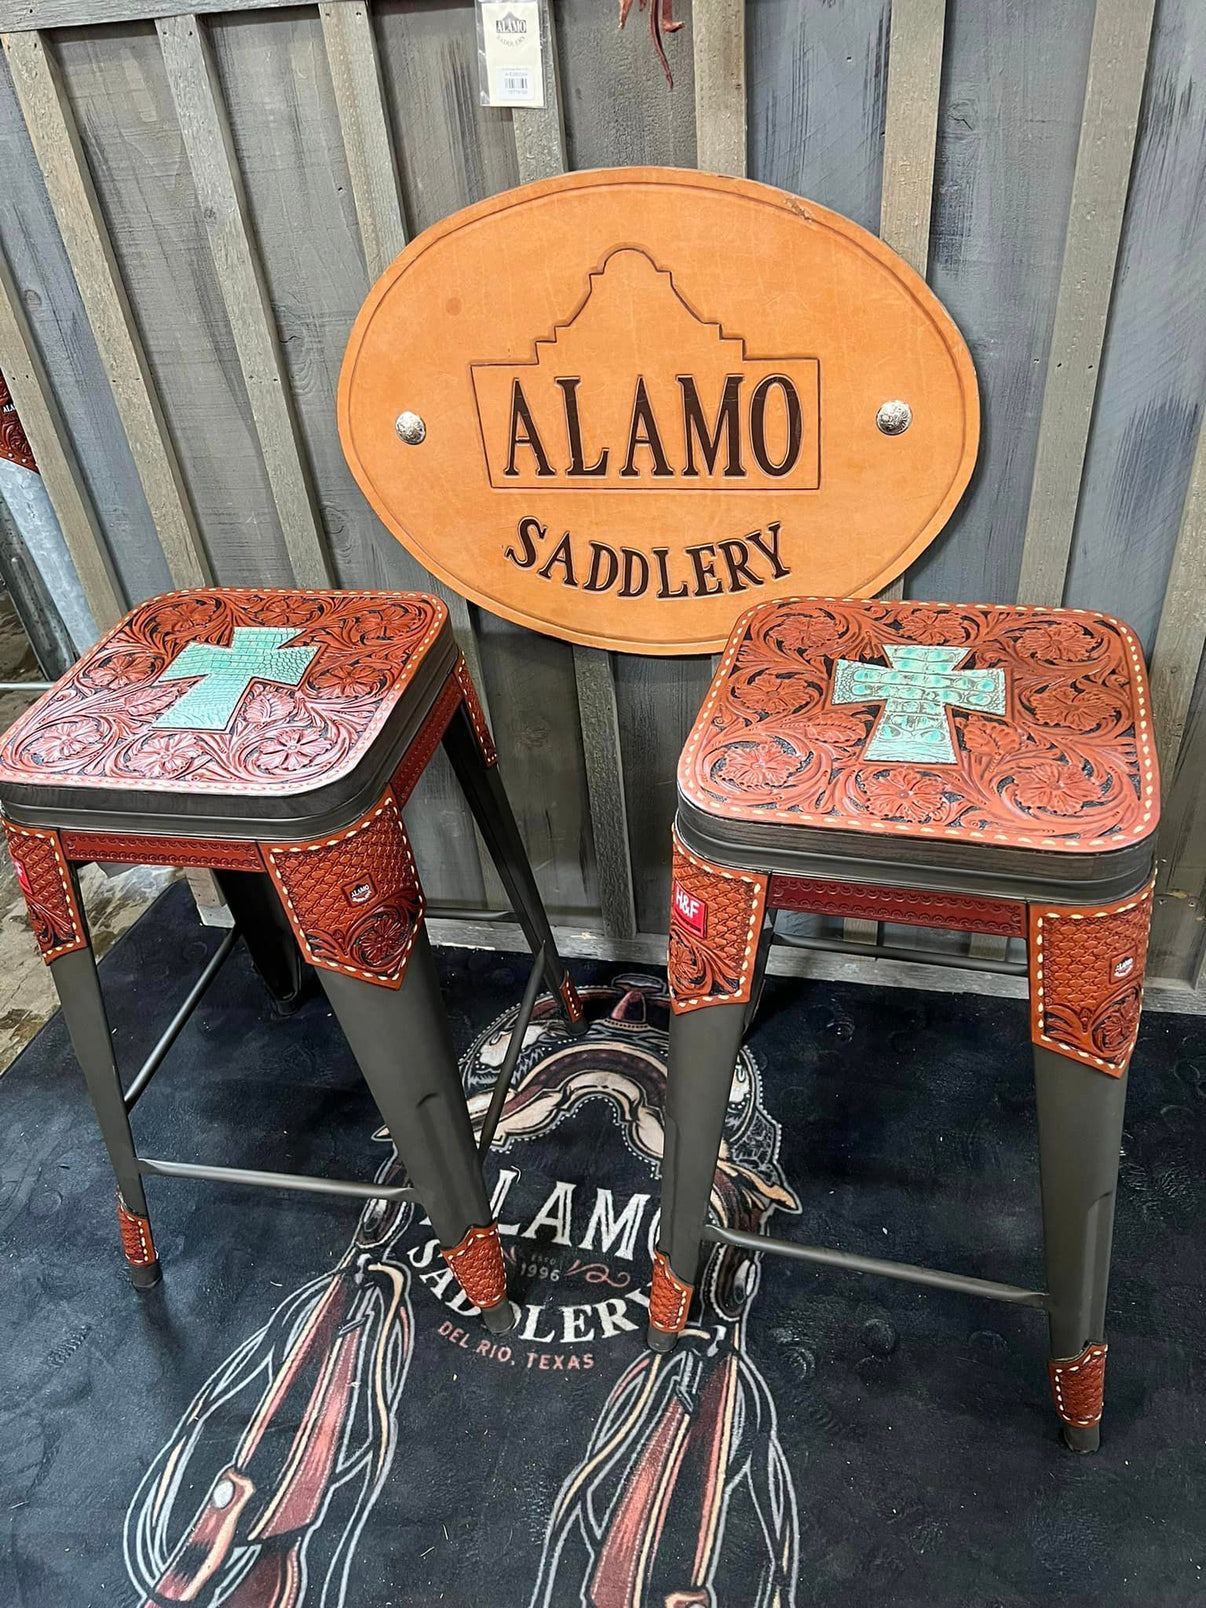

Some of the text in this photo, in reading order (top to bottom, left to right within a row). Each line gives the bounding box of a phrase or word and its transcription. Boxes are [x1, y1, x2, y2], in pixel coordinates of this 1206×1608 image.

[504, 374, 802, 476] ALAMO
[505, 516, 791, 598] SADDLERY
[675, 885, 700, 919] H&F
[520, 1262, 560, 1282] 1996
[438, 1321, 595, 1370] DEL RIO, TEXAS
